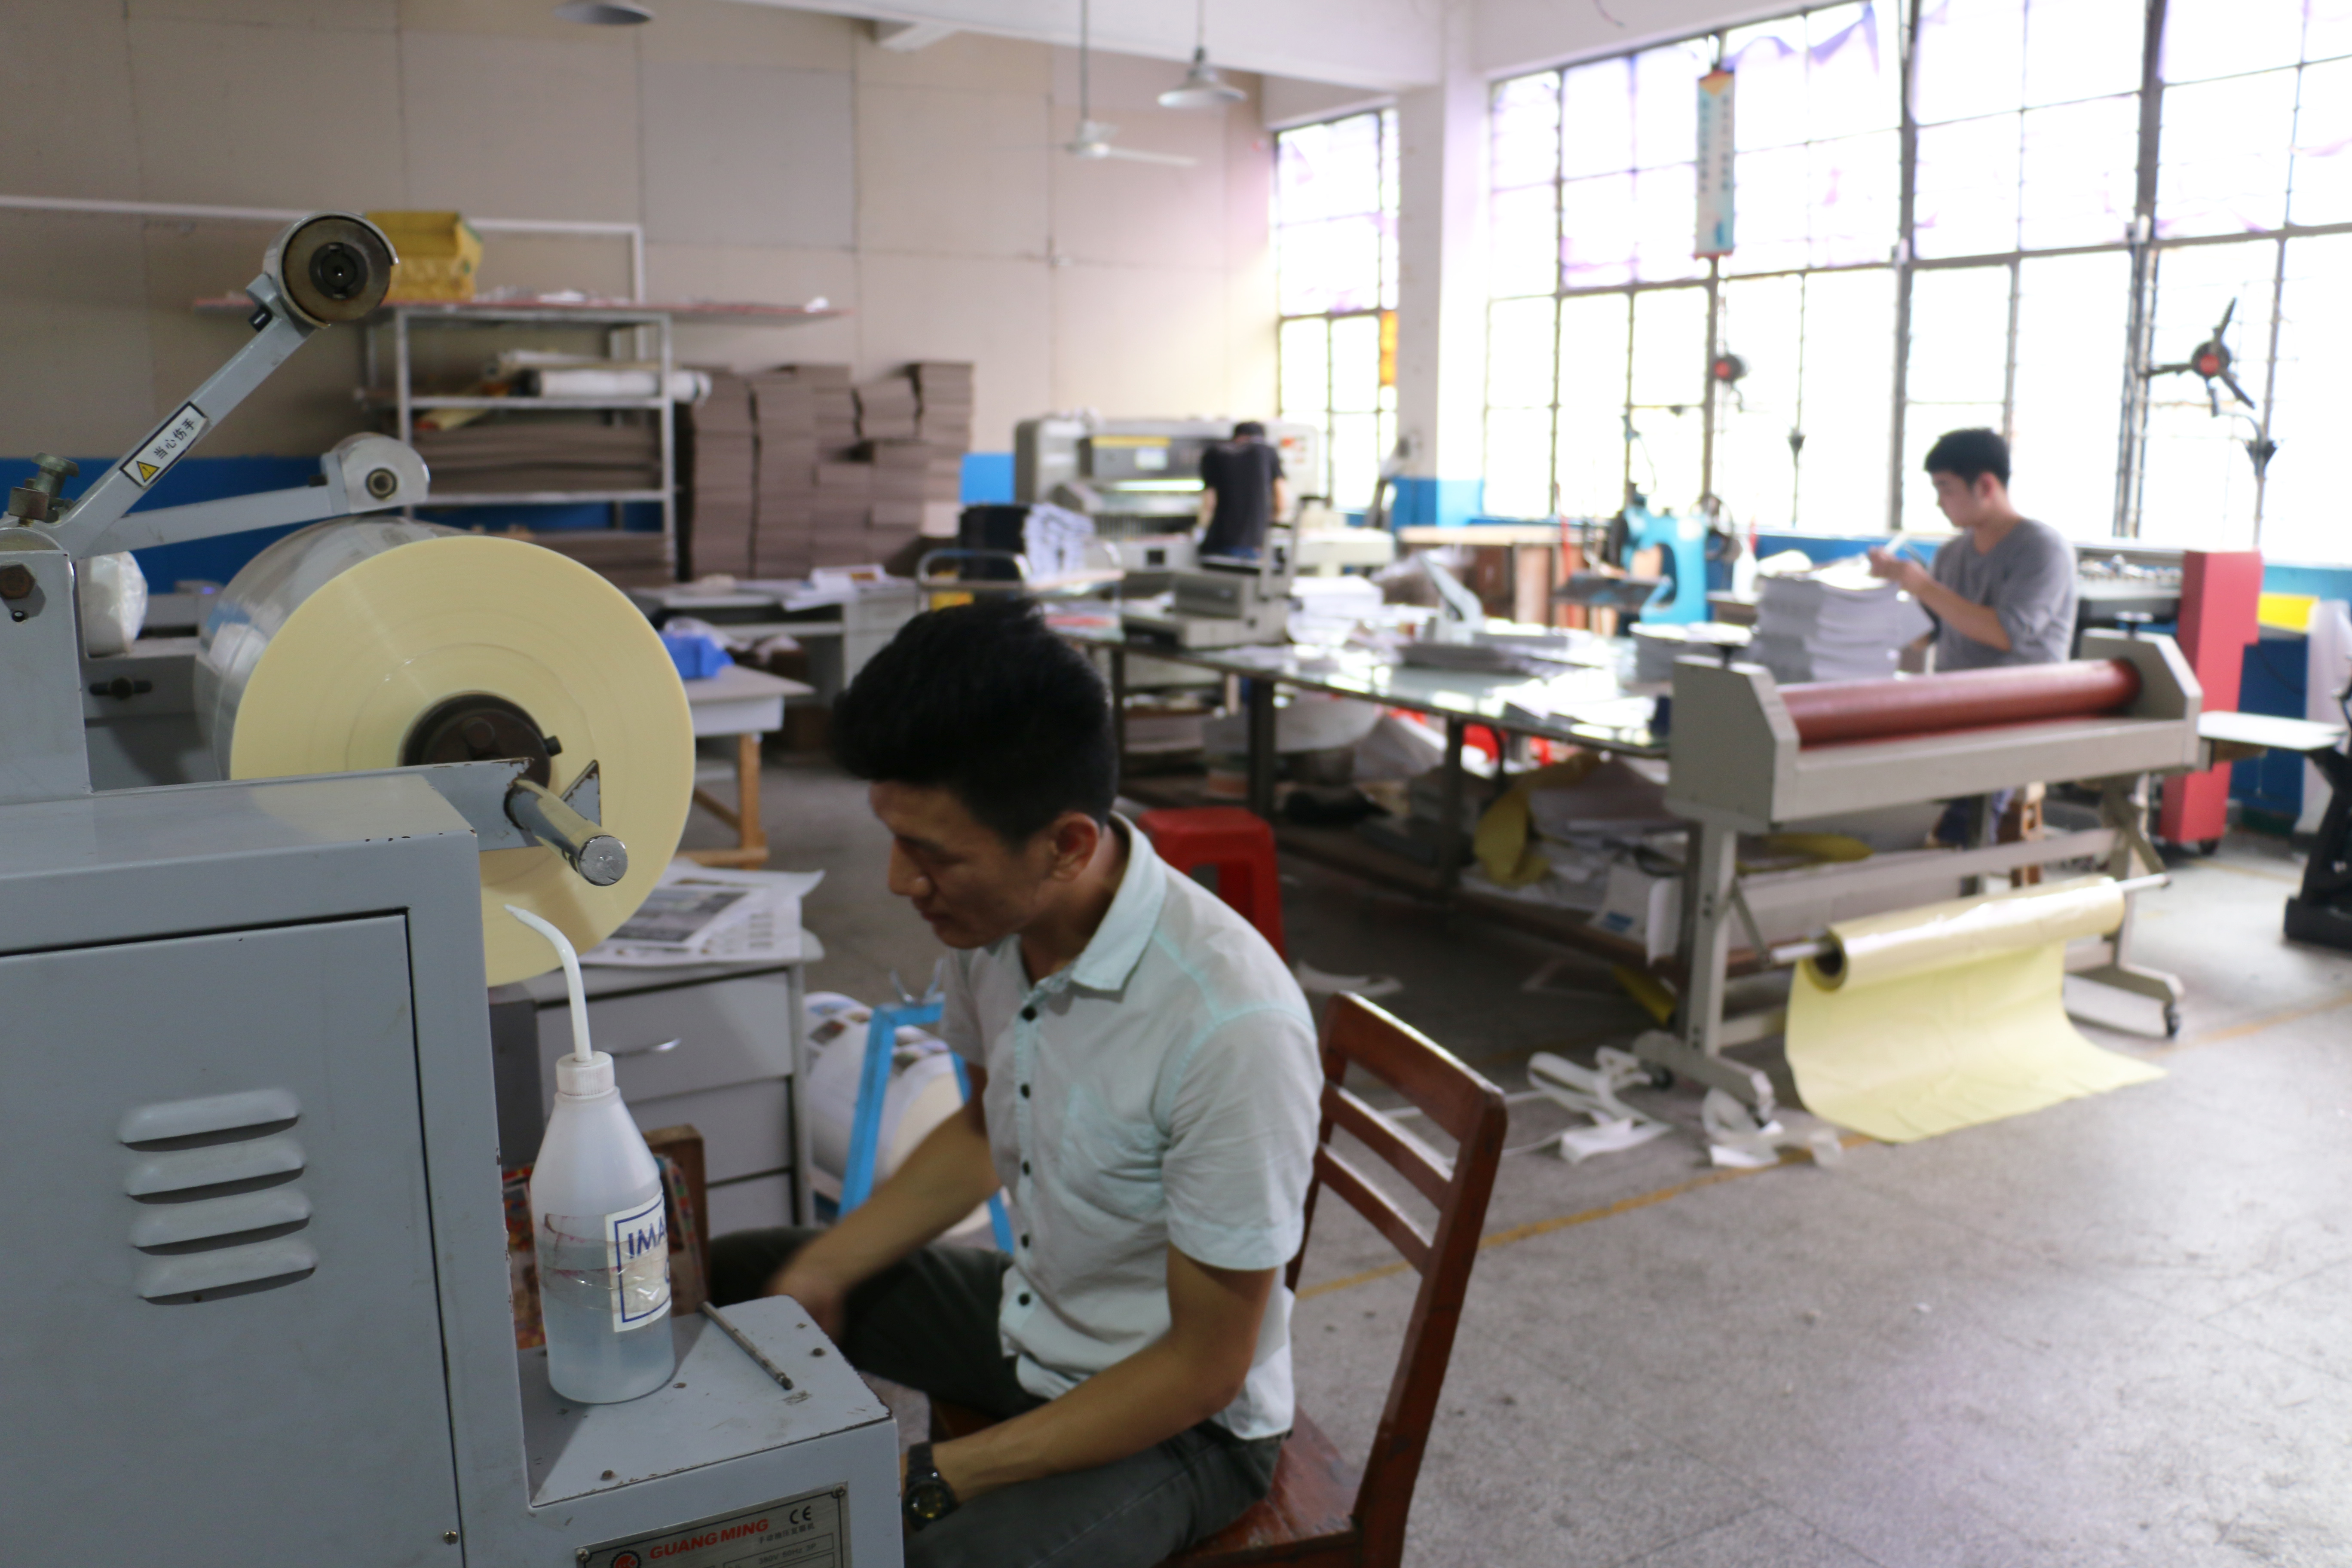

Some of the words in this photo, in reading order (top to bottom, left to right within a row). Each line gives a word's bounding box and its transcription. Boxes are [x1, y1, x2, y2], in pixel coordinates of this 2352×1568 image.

[154, 418, 194, 459] 当心伤手
[789, 1505, 812, 1525] CE
[649, 1533, 718, 1559] GUANG
[721, 1519, 769, 1542] MING
[759, 1553, 779, 1565] 380V
